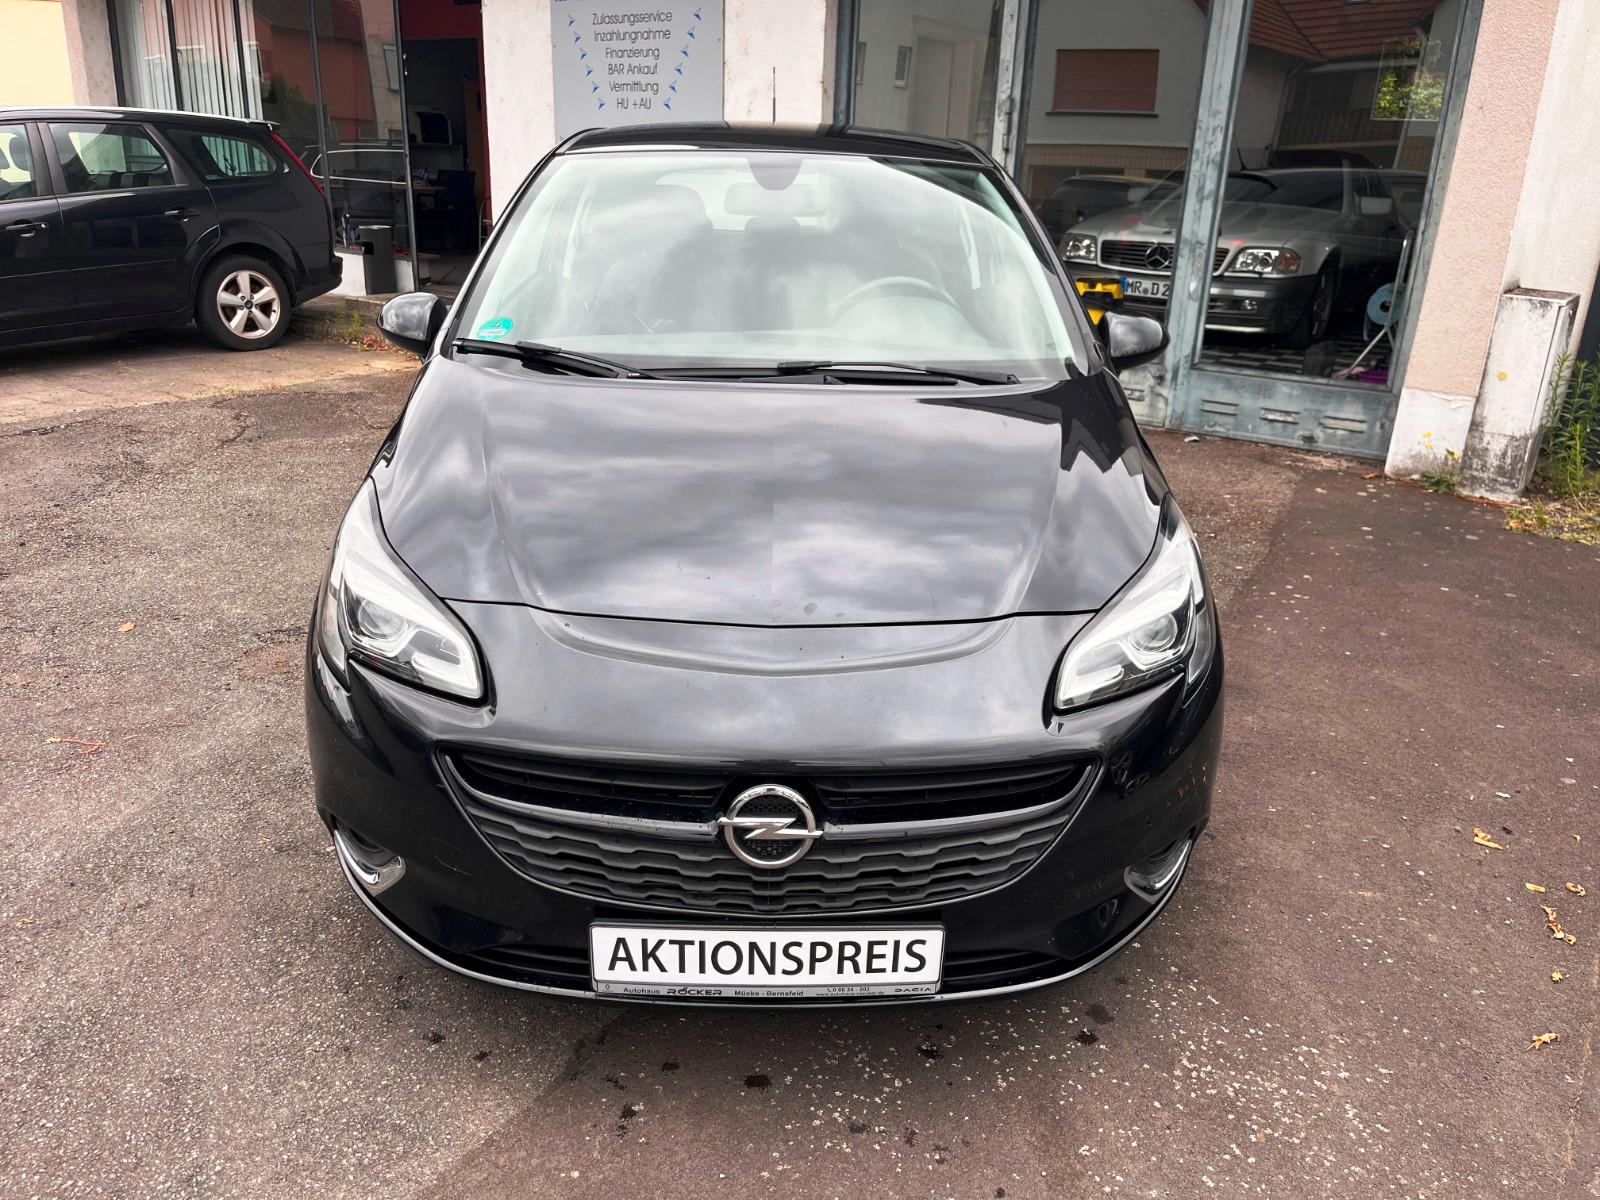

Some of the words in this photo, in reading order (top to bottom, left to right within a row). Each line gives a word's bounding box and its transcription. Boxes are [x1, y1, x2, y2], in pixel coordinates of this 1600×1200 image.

[591, 10, 672, 26] Zulassungsservice
[593, 28, 671, 43] Inzahlungnahme
[605, 47, 660, 60] Finanzierung
[608, 63, 625, 75] BAR
[626, 63, 658, 75] Ankauf
[608, 80, 659, 95] Vermittlung
[616, 98, 629, 110] HU
[1126, 279, 1142, 295] MR
[1150, 282, 1160, 296] D
[607, 937, 928, 976] AKTIONSPREIS
[623, 986, 660, 995] Autohaus
